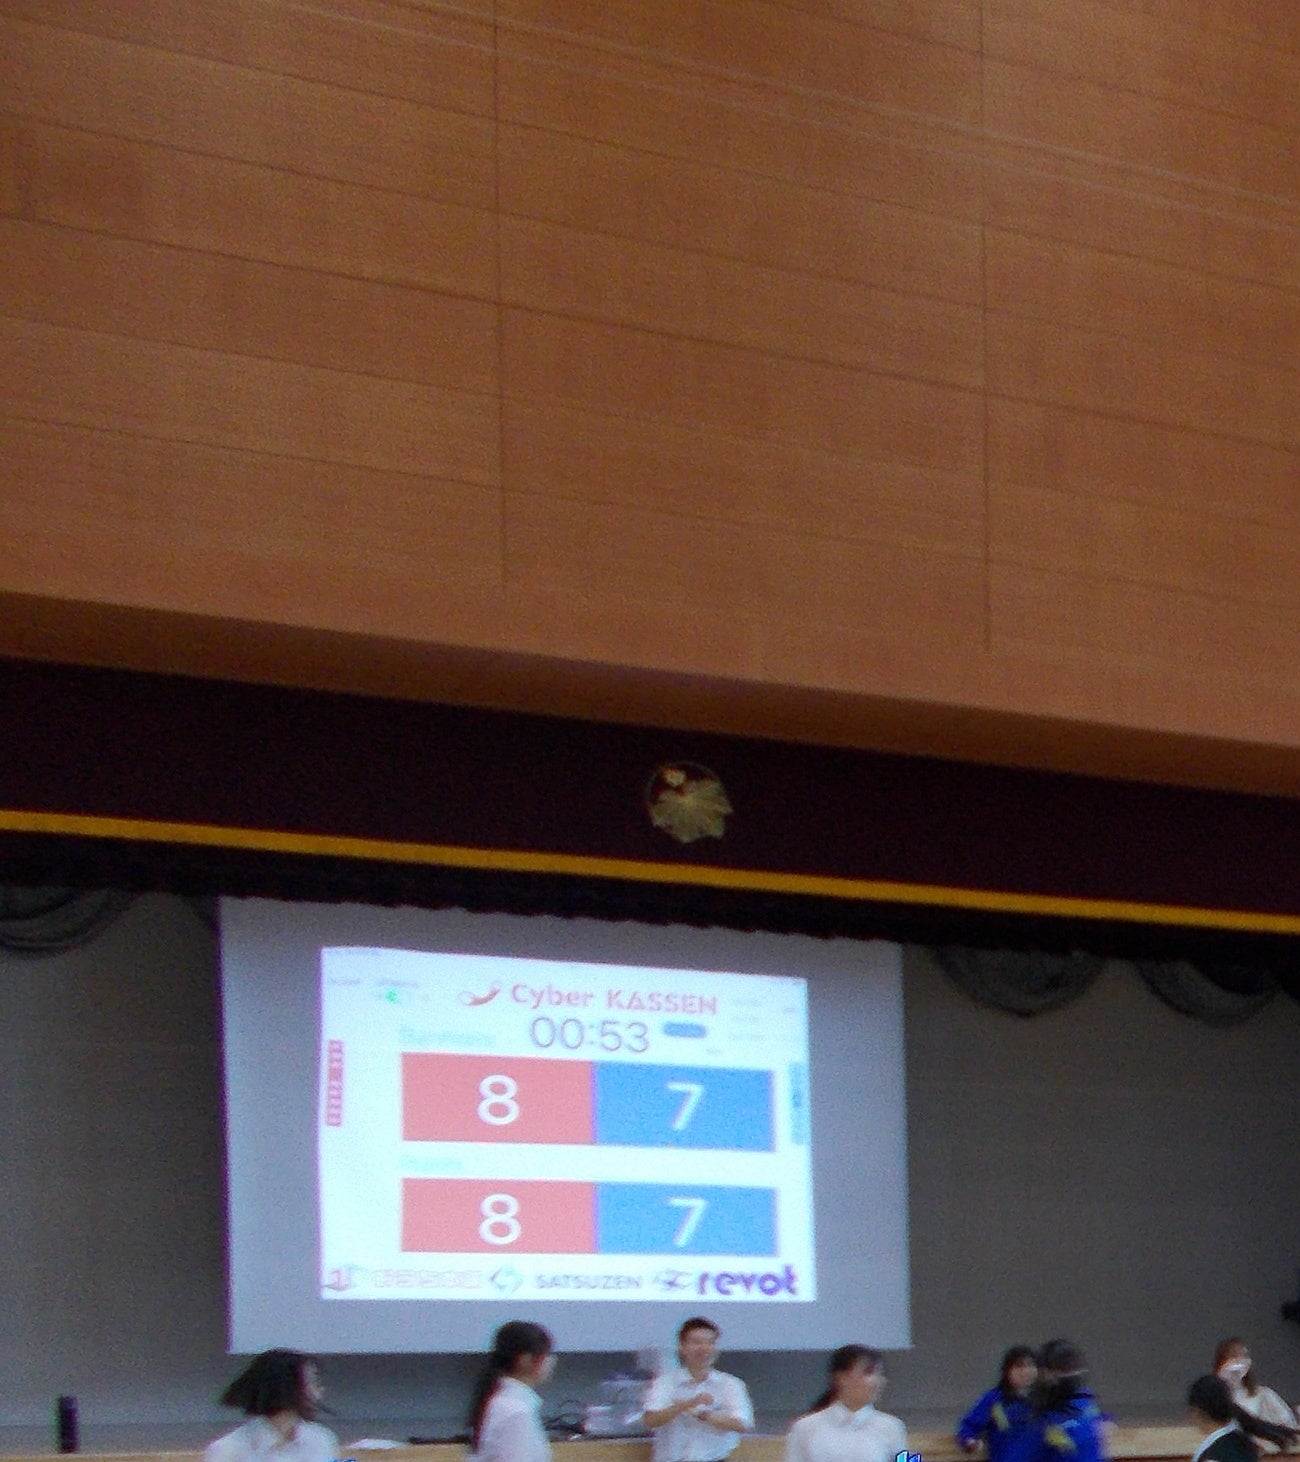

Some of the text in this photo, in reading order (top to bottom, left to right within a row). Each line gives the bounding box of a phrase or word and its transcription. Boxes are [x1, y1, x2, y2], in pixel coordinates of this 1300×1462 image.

[510, 983, 718, 1016] Cyber KASSEN
[529, 1016, 650, 1054] 00:53
[475, 1074, 521, 1126] 8
[667, 1081, 706, 1132] 7
[477, 1192, 523, 1245] 8
[669, 1198, 708, 1250] 7
[535, 1273, 643, 1290] SATSUZEN
[697, 1264, 797, 1296] revot
